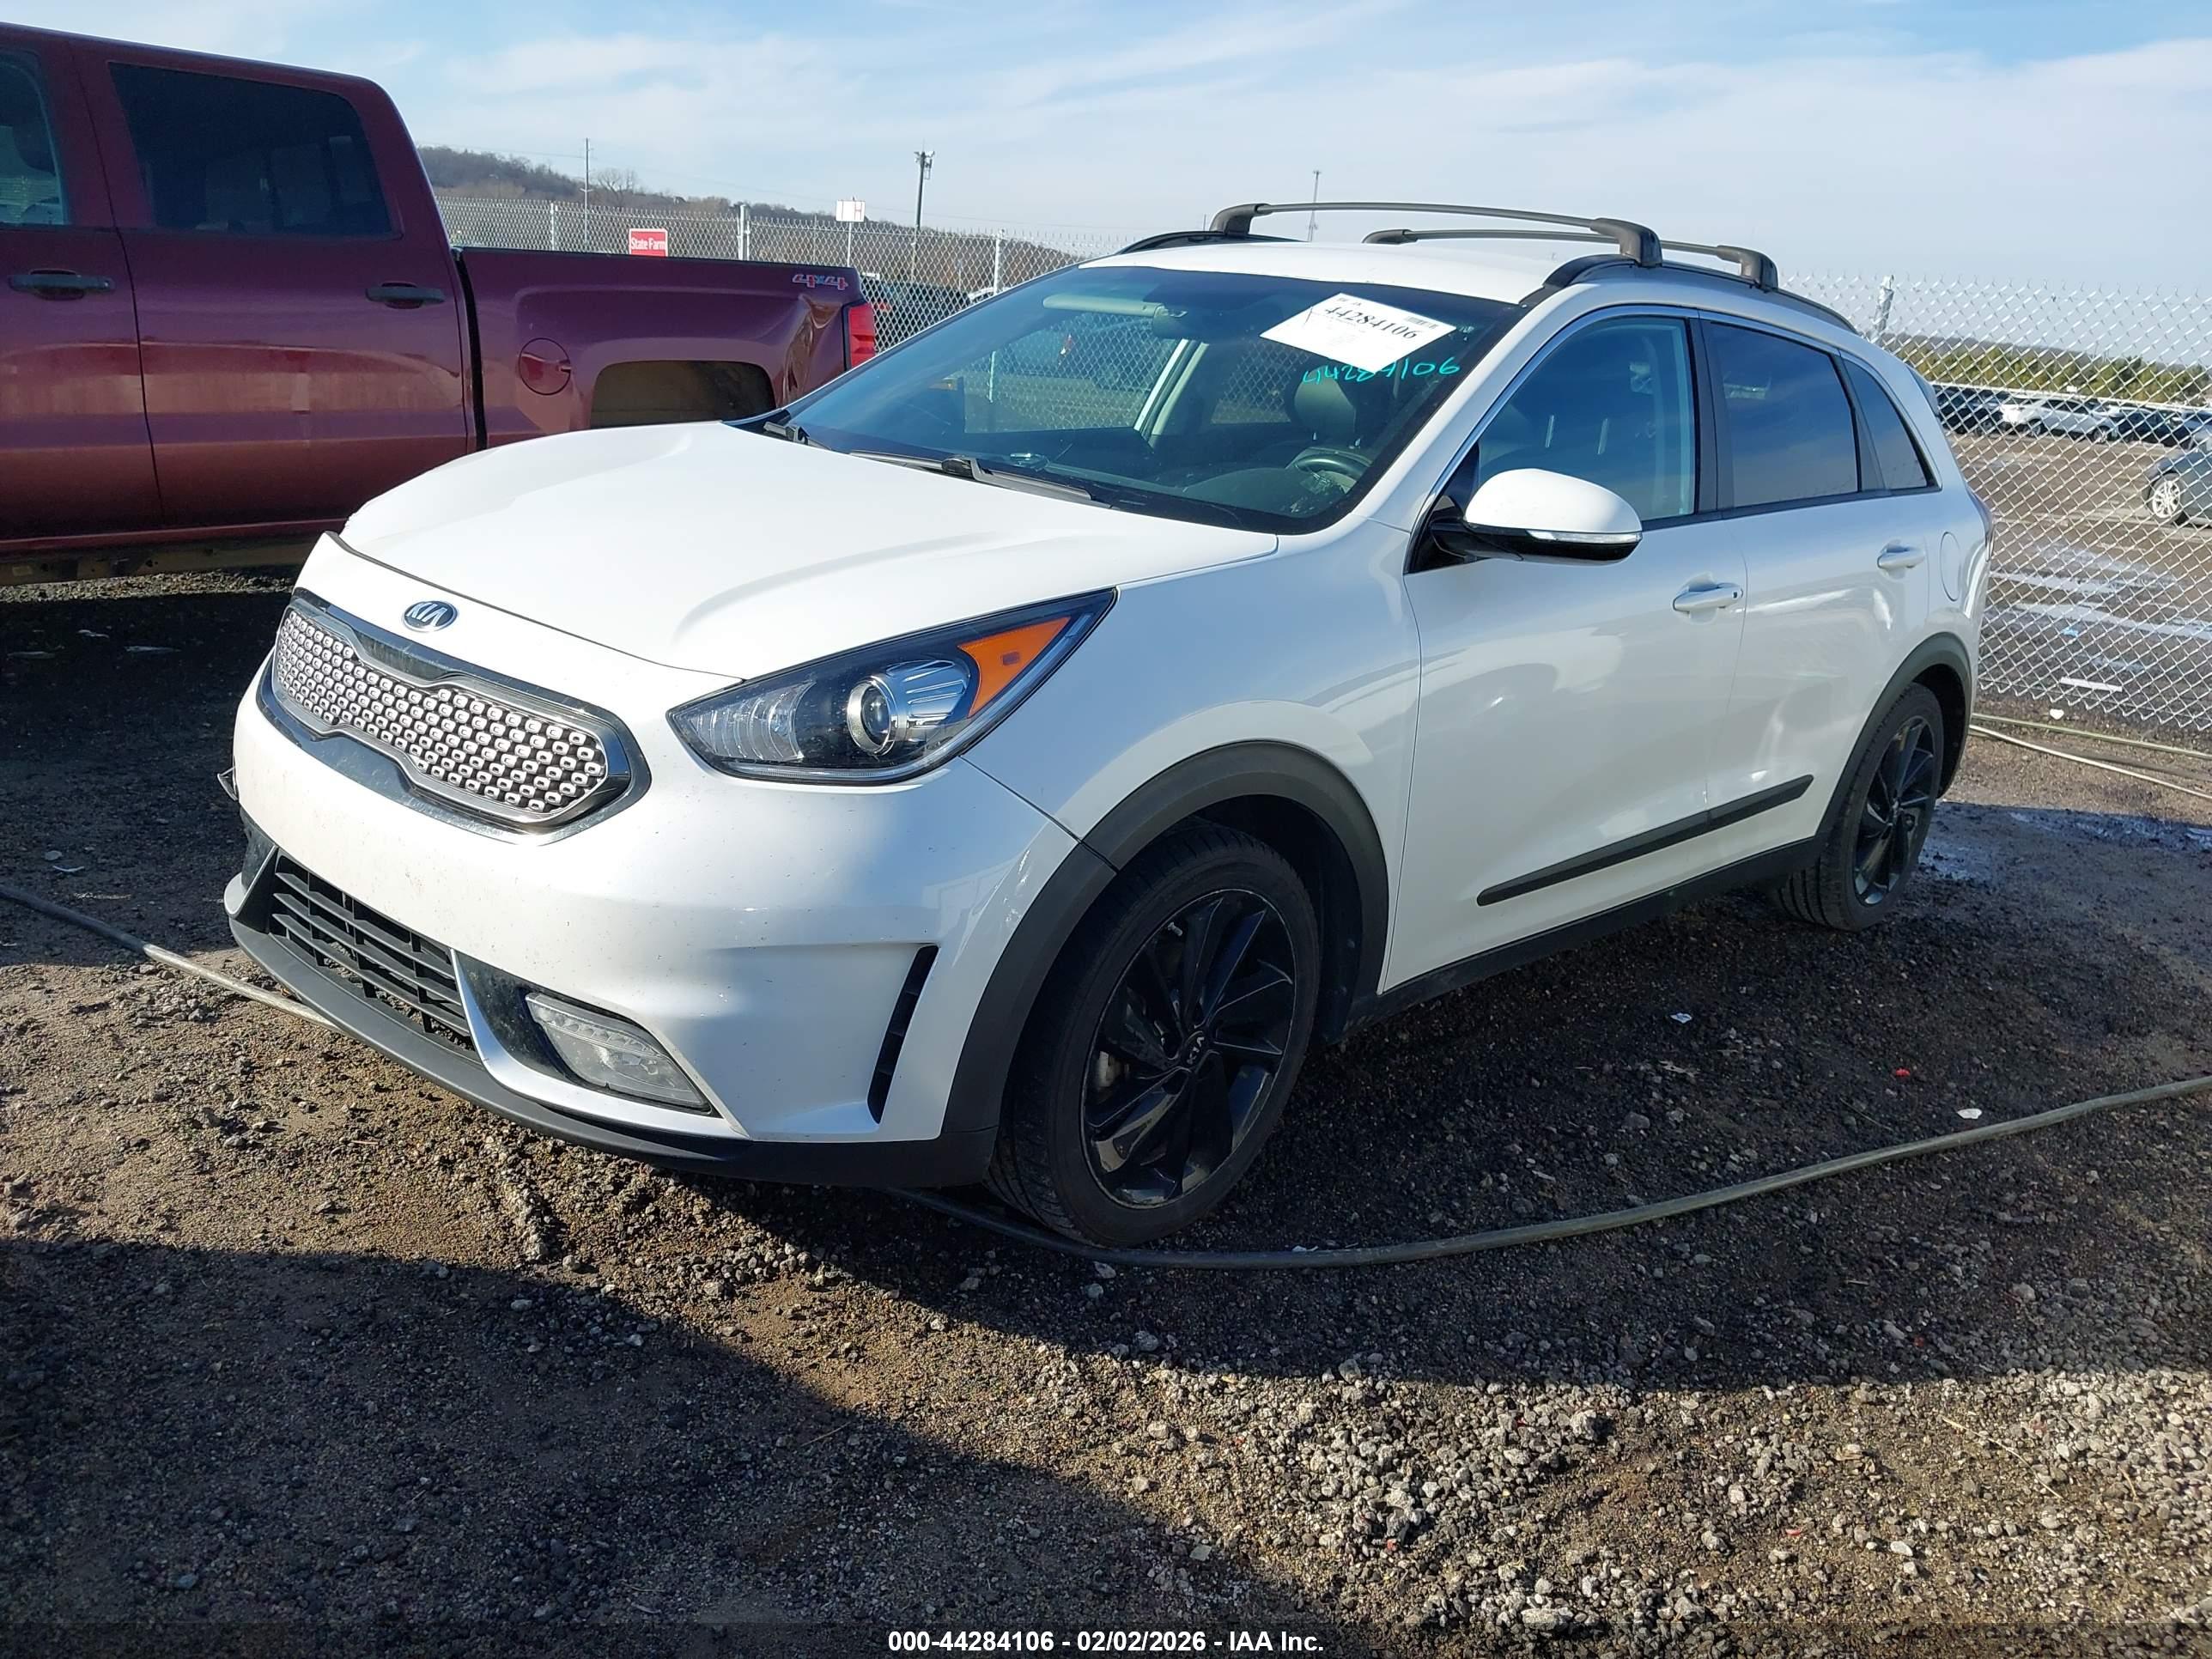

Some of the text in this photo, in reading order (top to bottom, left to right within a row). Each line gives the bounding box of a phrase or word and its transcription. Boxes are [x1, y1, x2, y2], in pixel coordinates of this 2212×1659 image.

[631, 237, 665, 250] State Farm
[1324, 307, 1422, 339] 44284106
[404, 602, 448, 628] KIA
